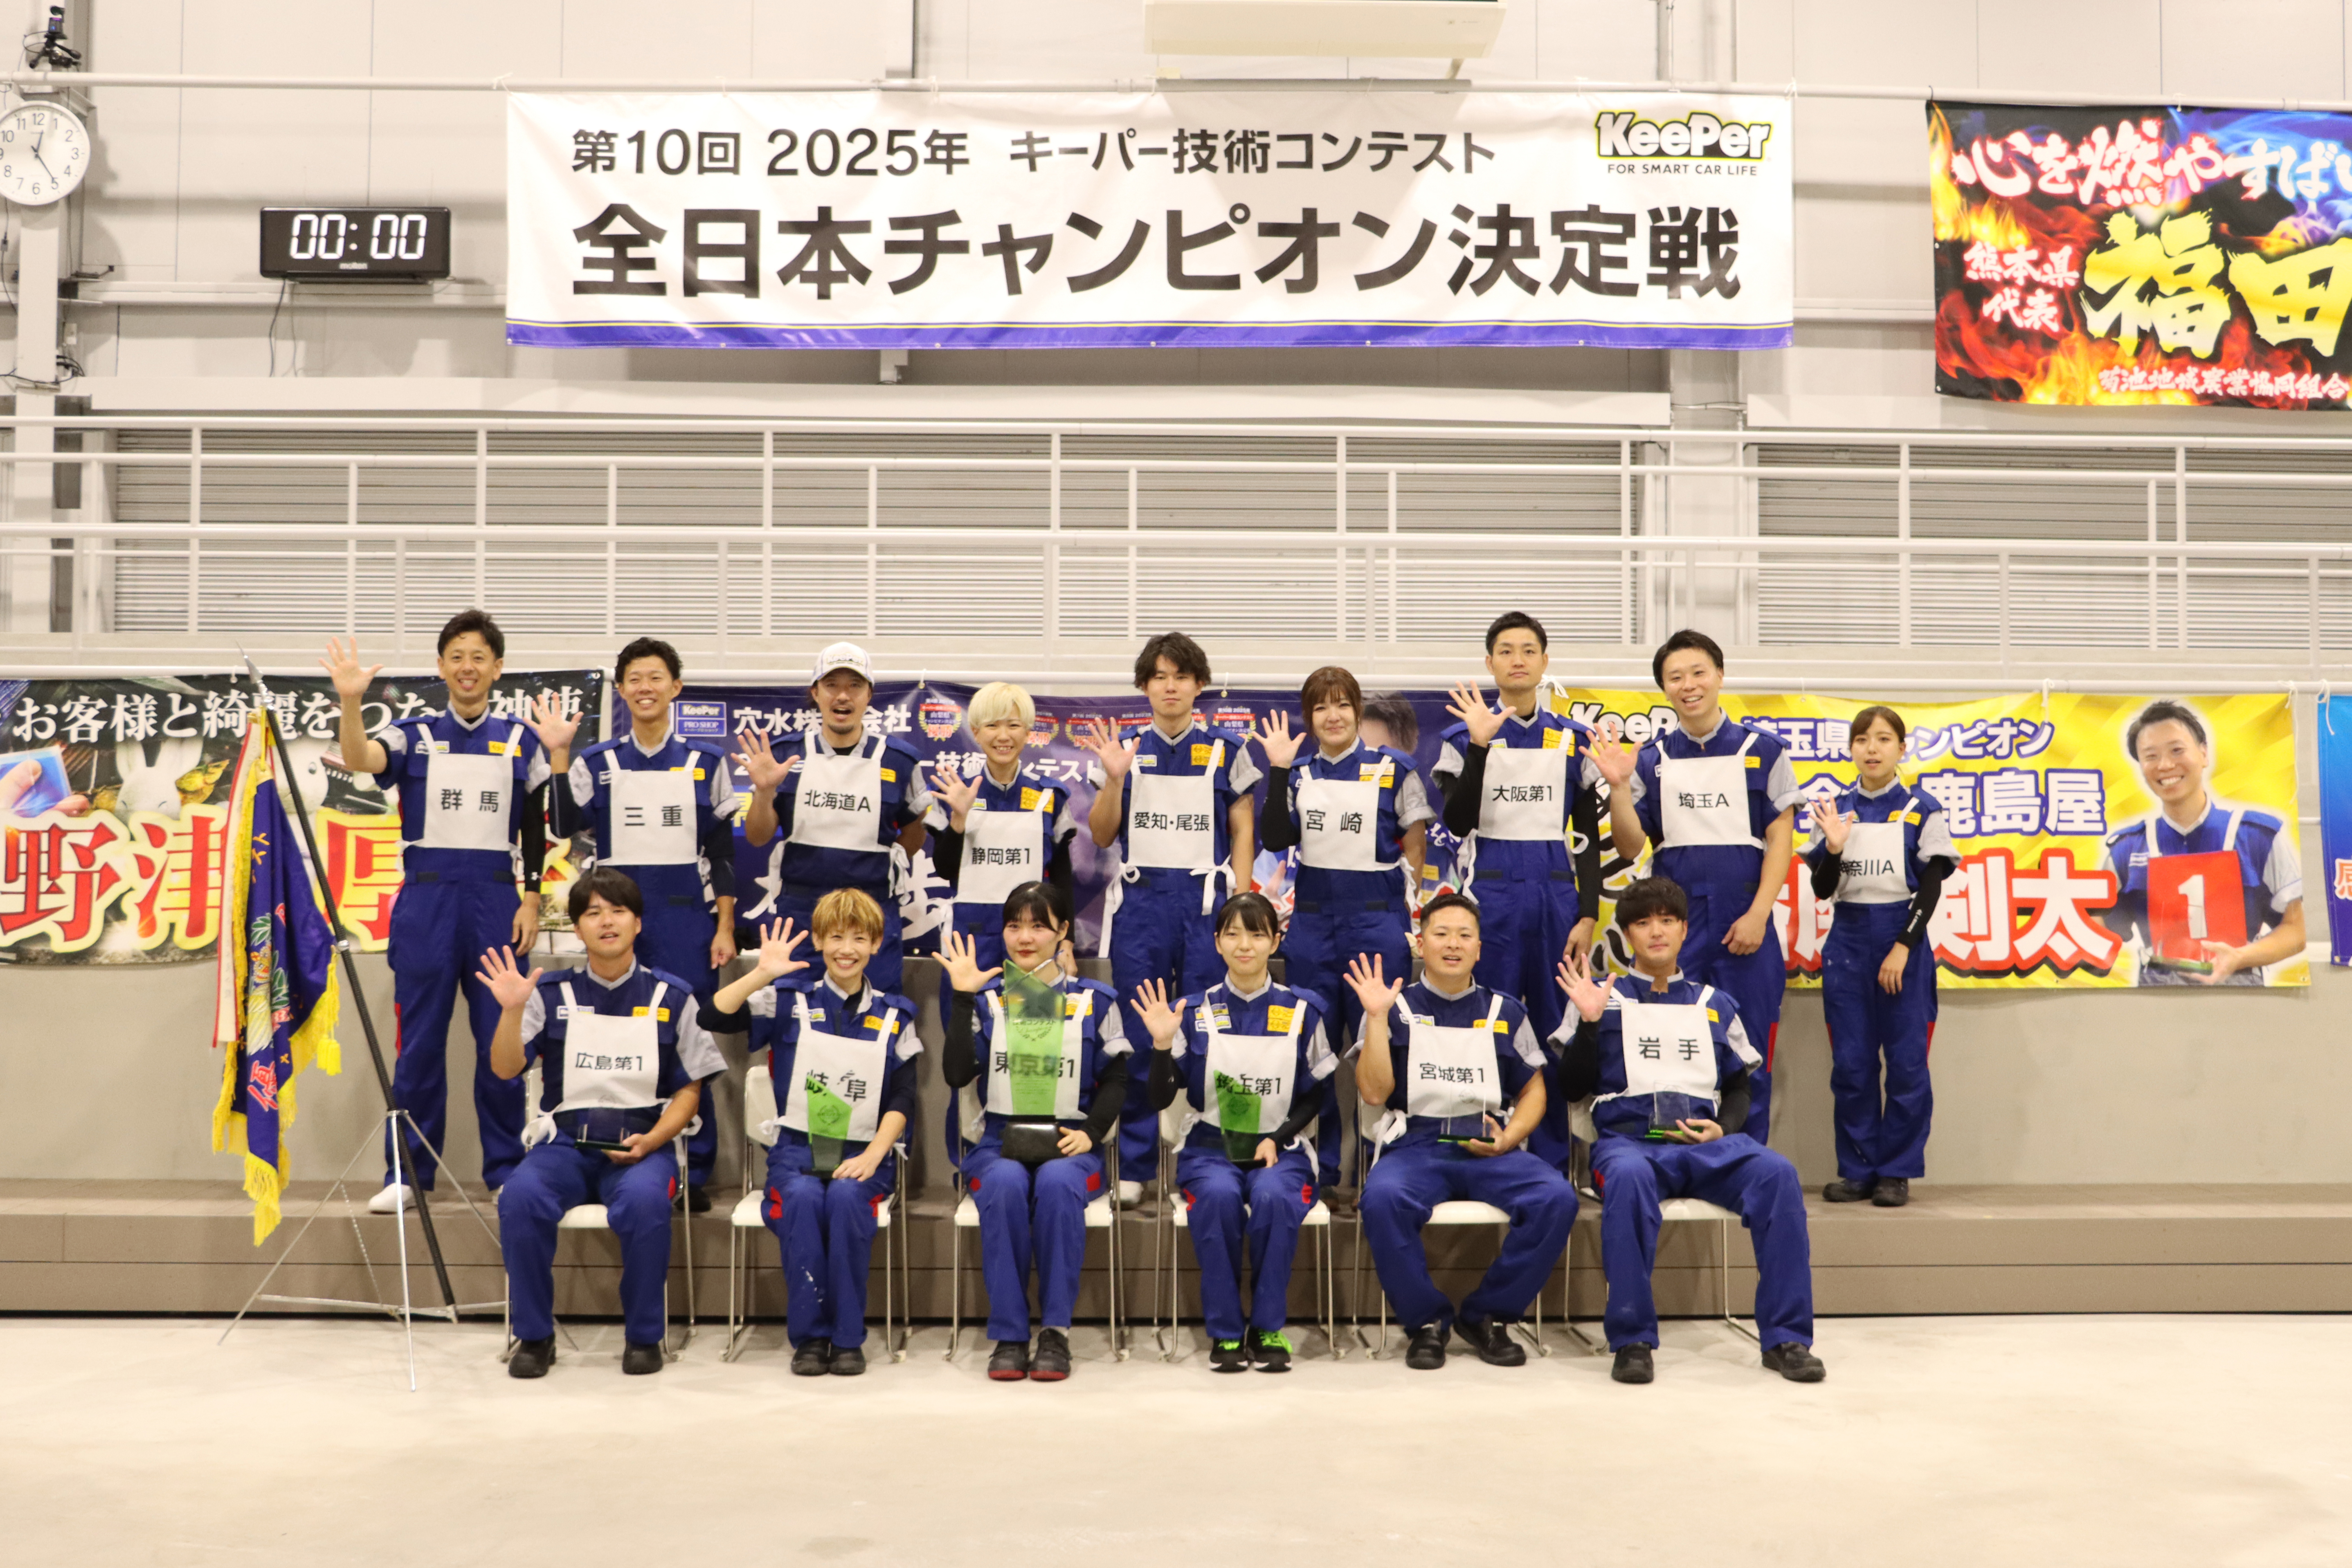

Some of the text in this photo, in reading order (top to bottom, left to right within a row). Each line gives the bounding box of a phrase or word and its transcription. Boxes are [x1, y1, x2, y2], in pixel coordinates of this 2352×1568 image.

[17, 118, 26, 130] 11
[32, 113, 45, 126] 12
[54, 118, 58, 130] 1
[2, 130, 14, 143] 10
[65, 130, 73, 142] 2
[1596, 112, 1771, 159] KeePer
[71, 148, 79, 160] 3
[571, 128, 1494, 177] 第10回 2025年 キーパー技術コンテスト
[4, 165, 11, 177] 8
[64, 165, 71, 177] 4
[1608, 164, 1756, 176] FOR SMART CAR LIFE
[16, 177, 24, 190] 7
[32, 182, 40, 195] 6
[51, 177, 59, 190] 5
[573, 203, 1741, 300] 全日本チャンピオン決定戦
[1963, 240, 2080, 288] 熊本県
[2080, 209, 2352, 359] 福田
[1983, 287, 2060, 332] 代表
[2098, 365, 2350, 399] 菊池地域農業協同組合
[682, 704, 720, 716] KeePer
[733, 704, 912, 735] 穴水株会社
[1570, 701, 1678, 744] KeeP
[441, 789, 499, 813] 群馬
[804, 789, 871, 813] 北海道A
[1492, 785, 1552, 802] 大阪第1
[1678, 792, 1730, 809] 埼玉A
[624, 805, 683, 827] 三重
[1134, 811, 1210, 831] 愛知・尾張
[1306, 809, 1363, 834] 宮崎
[971, 847, 1030, 865] 静岡第1
[2178, 874, 2208, 939] 1
[1638, 1037, 1700, 1060] 岩手
[575, 1052, 643, 1071] 広島第1
[1419, 1062, 1484, 1084] 宮城第1
